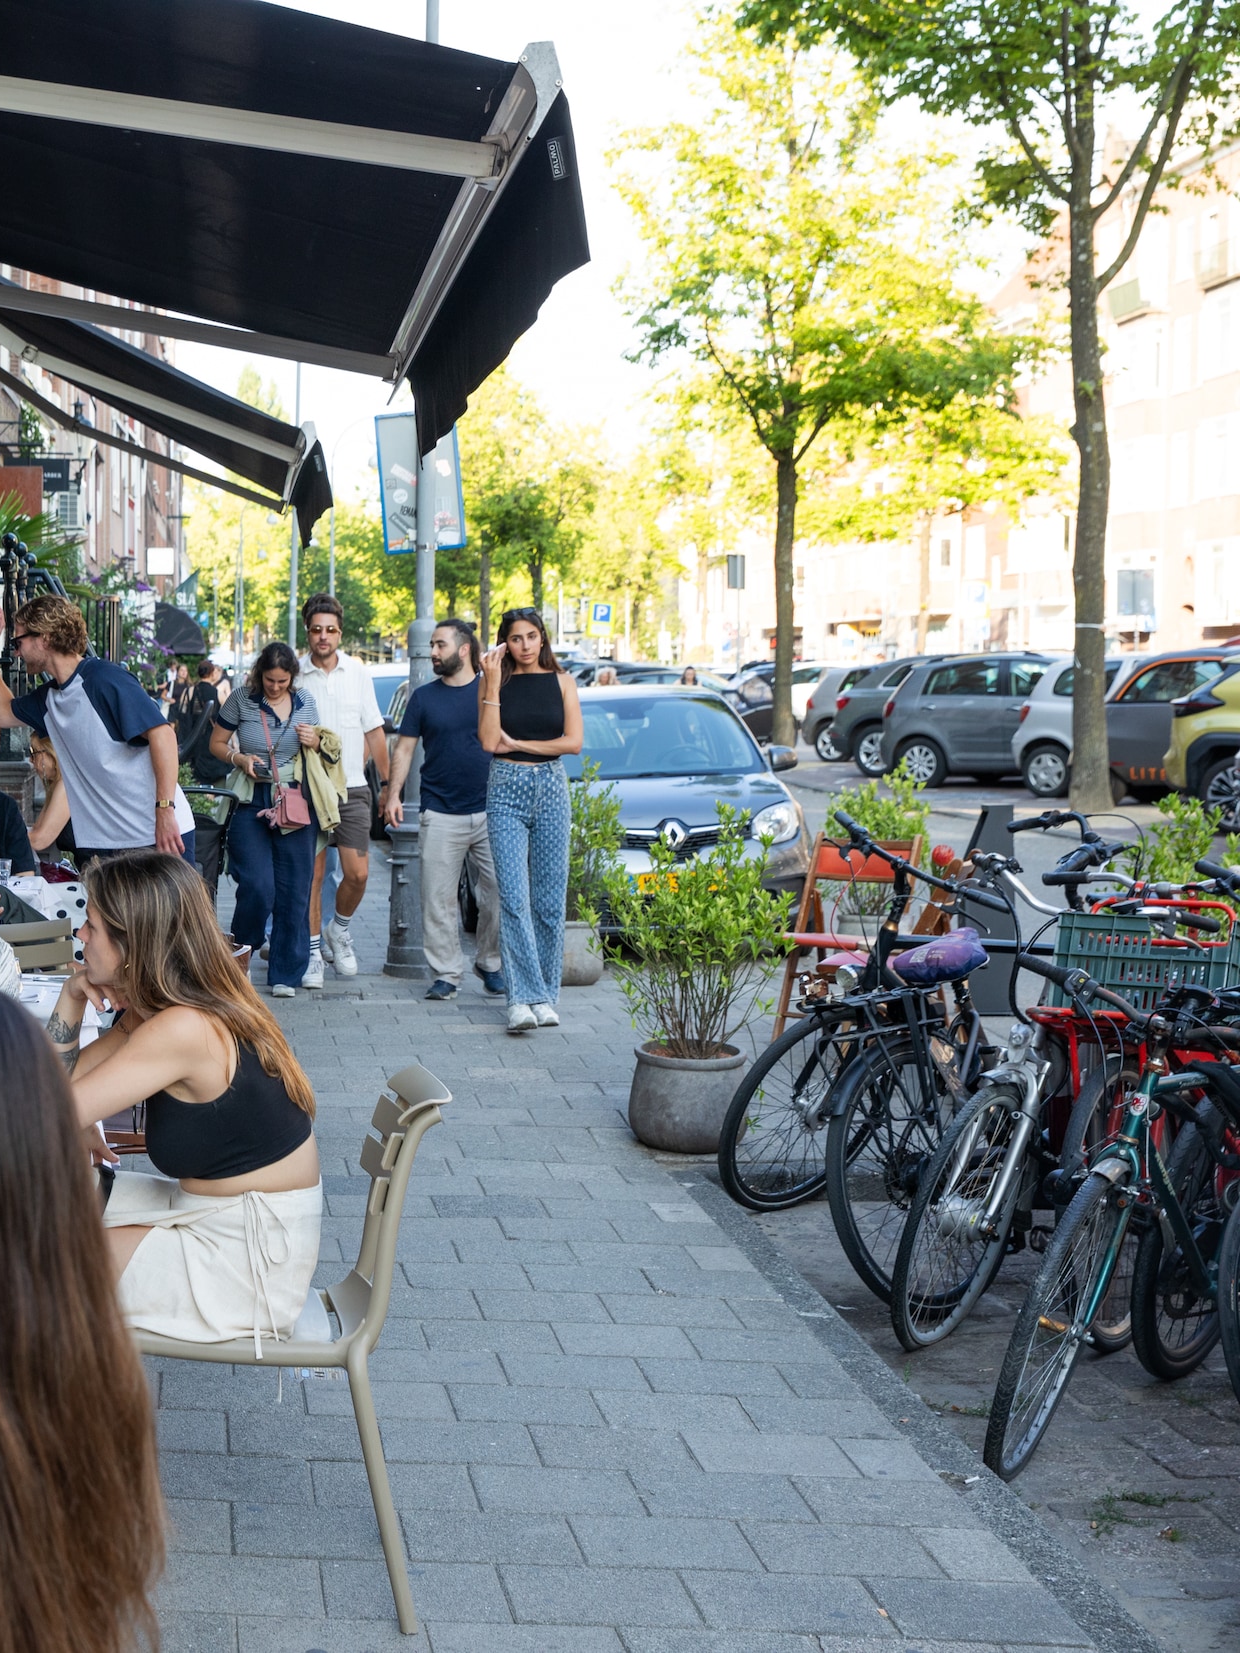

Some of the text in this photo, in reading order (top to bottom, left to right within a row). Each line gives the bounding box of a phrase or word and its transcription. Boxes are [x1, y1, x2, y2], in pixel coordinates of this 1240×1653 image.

[549, 144, 561, 175] PALMO
[176, 591, 196, 606] SLA
[596, 605, 608, 620] P
